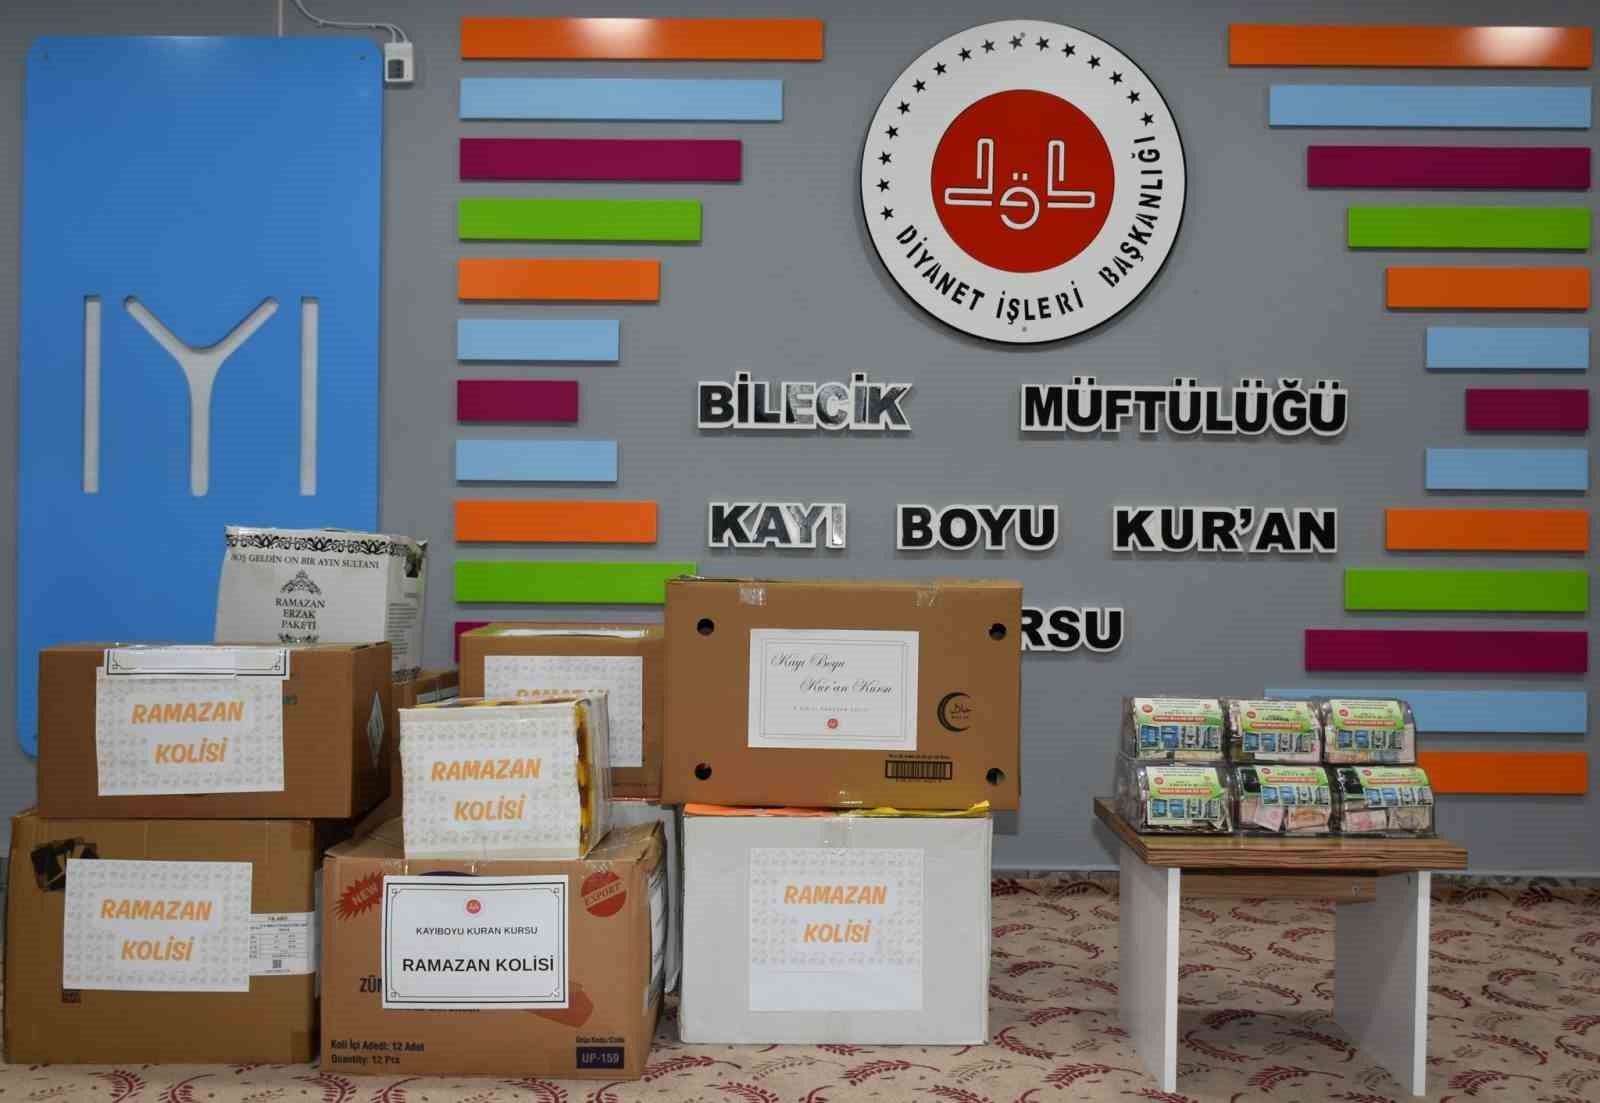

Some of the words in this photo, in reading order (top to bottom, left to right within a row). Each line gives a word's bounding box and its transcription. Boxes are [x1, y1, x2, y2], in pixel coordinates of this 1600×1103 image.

[896, 225, 985, 311] DİYANET
[996, 281, 1084, 325] İŞLERİ
[1098, 136, 1163, 288] BAŞKANLIĞI
[698, 371, 912, 430] BİLECİK
[1021, 376, 1349, 437] MÜFTÜLÜĞÜ
[708, 502, 846, 549] KAYI
[896, 503, 1059, 551] BOYU
[275, 598, 326, 609] RAMAZAN
[283, 609, 316, 619] ERZAK
[1021, 606, 1124, 652] RSU
[131, 701, 245, 725] RAMAZAN
[154, 736, 229, 766] KOLİSİ
[431, 757, 543, 782] RAMAZAN
[453, 793, 529, 822] KOLİSİ
[783, 884, 888, 905] RAMAZAN
[99, 898, 212, 921] RAMAZAN
[416, 927, 465, 936] KAYIBOYU
[466, 927, 502, 935] KURAN
[504, 926, 539, 935] KURSU
[803, 919, 871, 944] KOLİSİ
[121, 935, 195, 961] KOLİSİ
[402, 958, 490, 972] RAMAZAN
[496, 955, 555, 972] KOLİSİ
